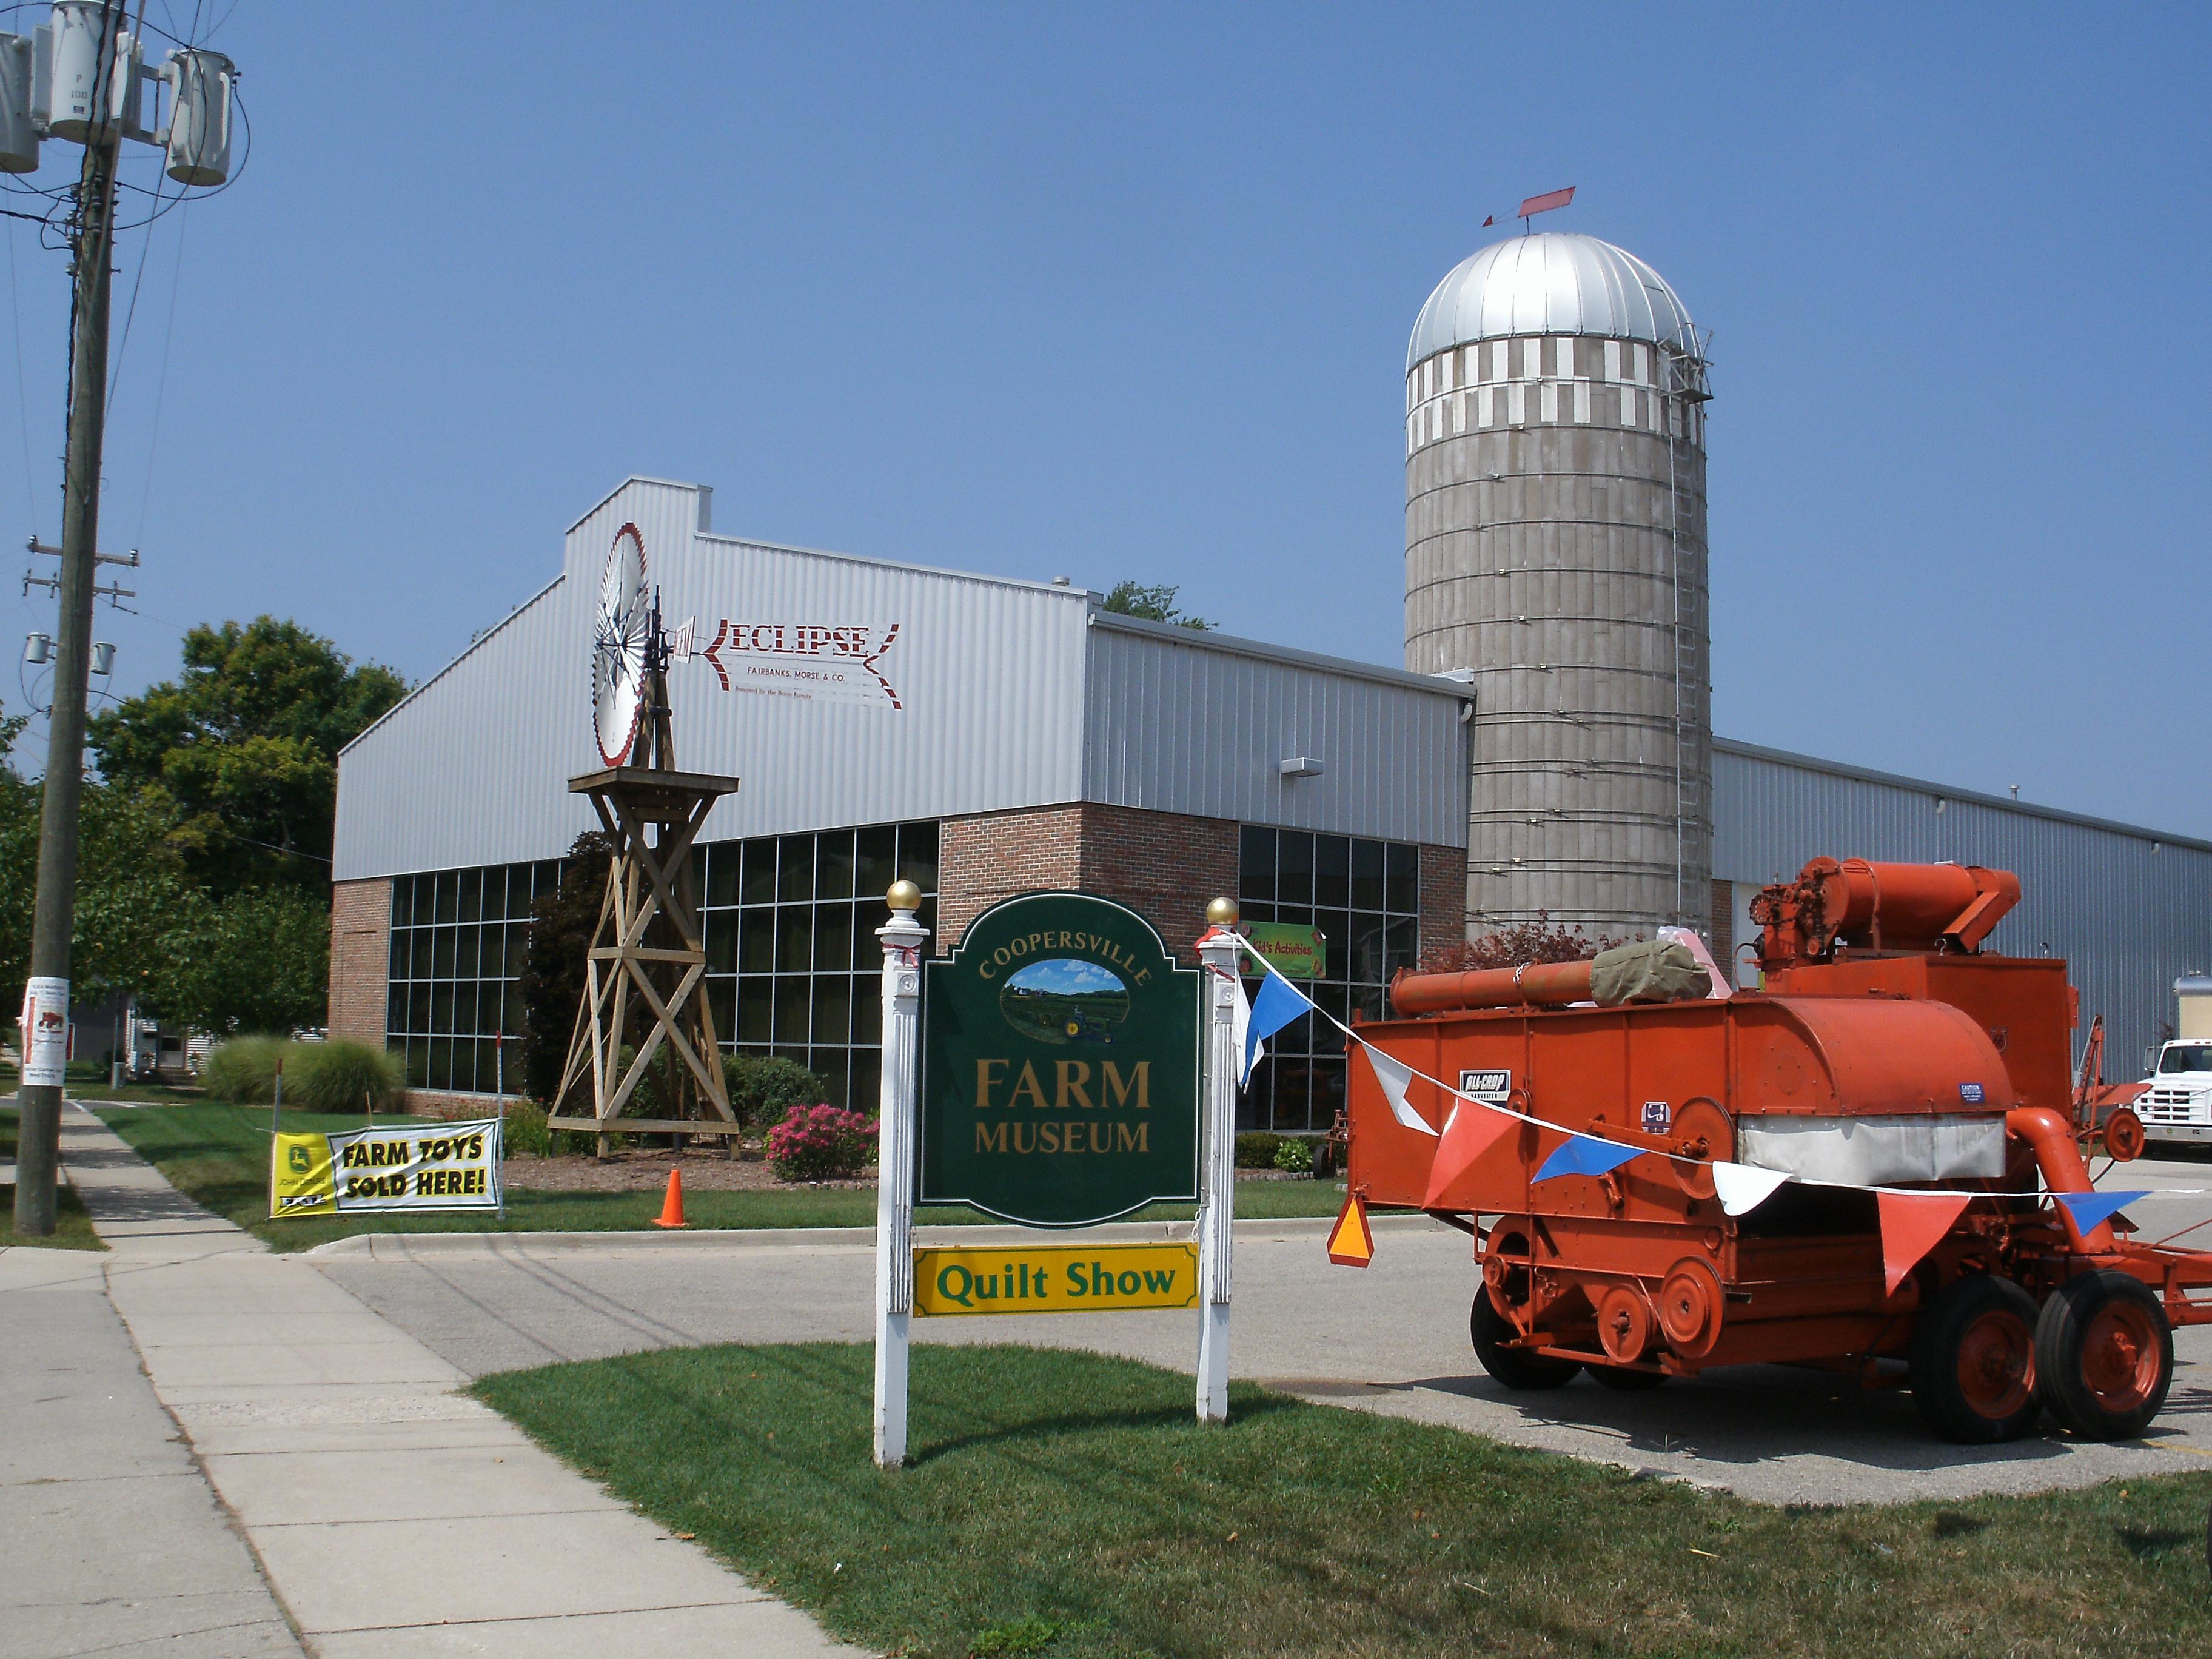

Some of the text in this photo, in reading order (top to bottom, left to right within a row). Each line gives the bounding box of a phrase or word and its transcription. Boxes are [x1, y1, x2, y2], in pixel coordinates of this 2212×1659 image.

[729, 624, 869, 658] ECLIPSE
[794, 671, 819, 680] MORSE
[979, 931, 1152, 986] COOPERSVILLE
[1253, 939, 1313, 956] Kid's Activities
[975, 1058, 1151, 1108] FARM
[1465, 1074, 1505, 1091] ALL-CROP
[343, 1136, 483, 1168] FARM TOYS
[975, 1122, 1151, 1153] MUSEUM
[345, 1169, 486, 1198] SOLD HERE!
[937, 1261, 1176, 1307] Quilt Show
